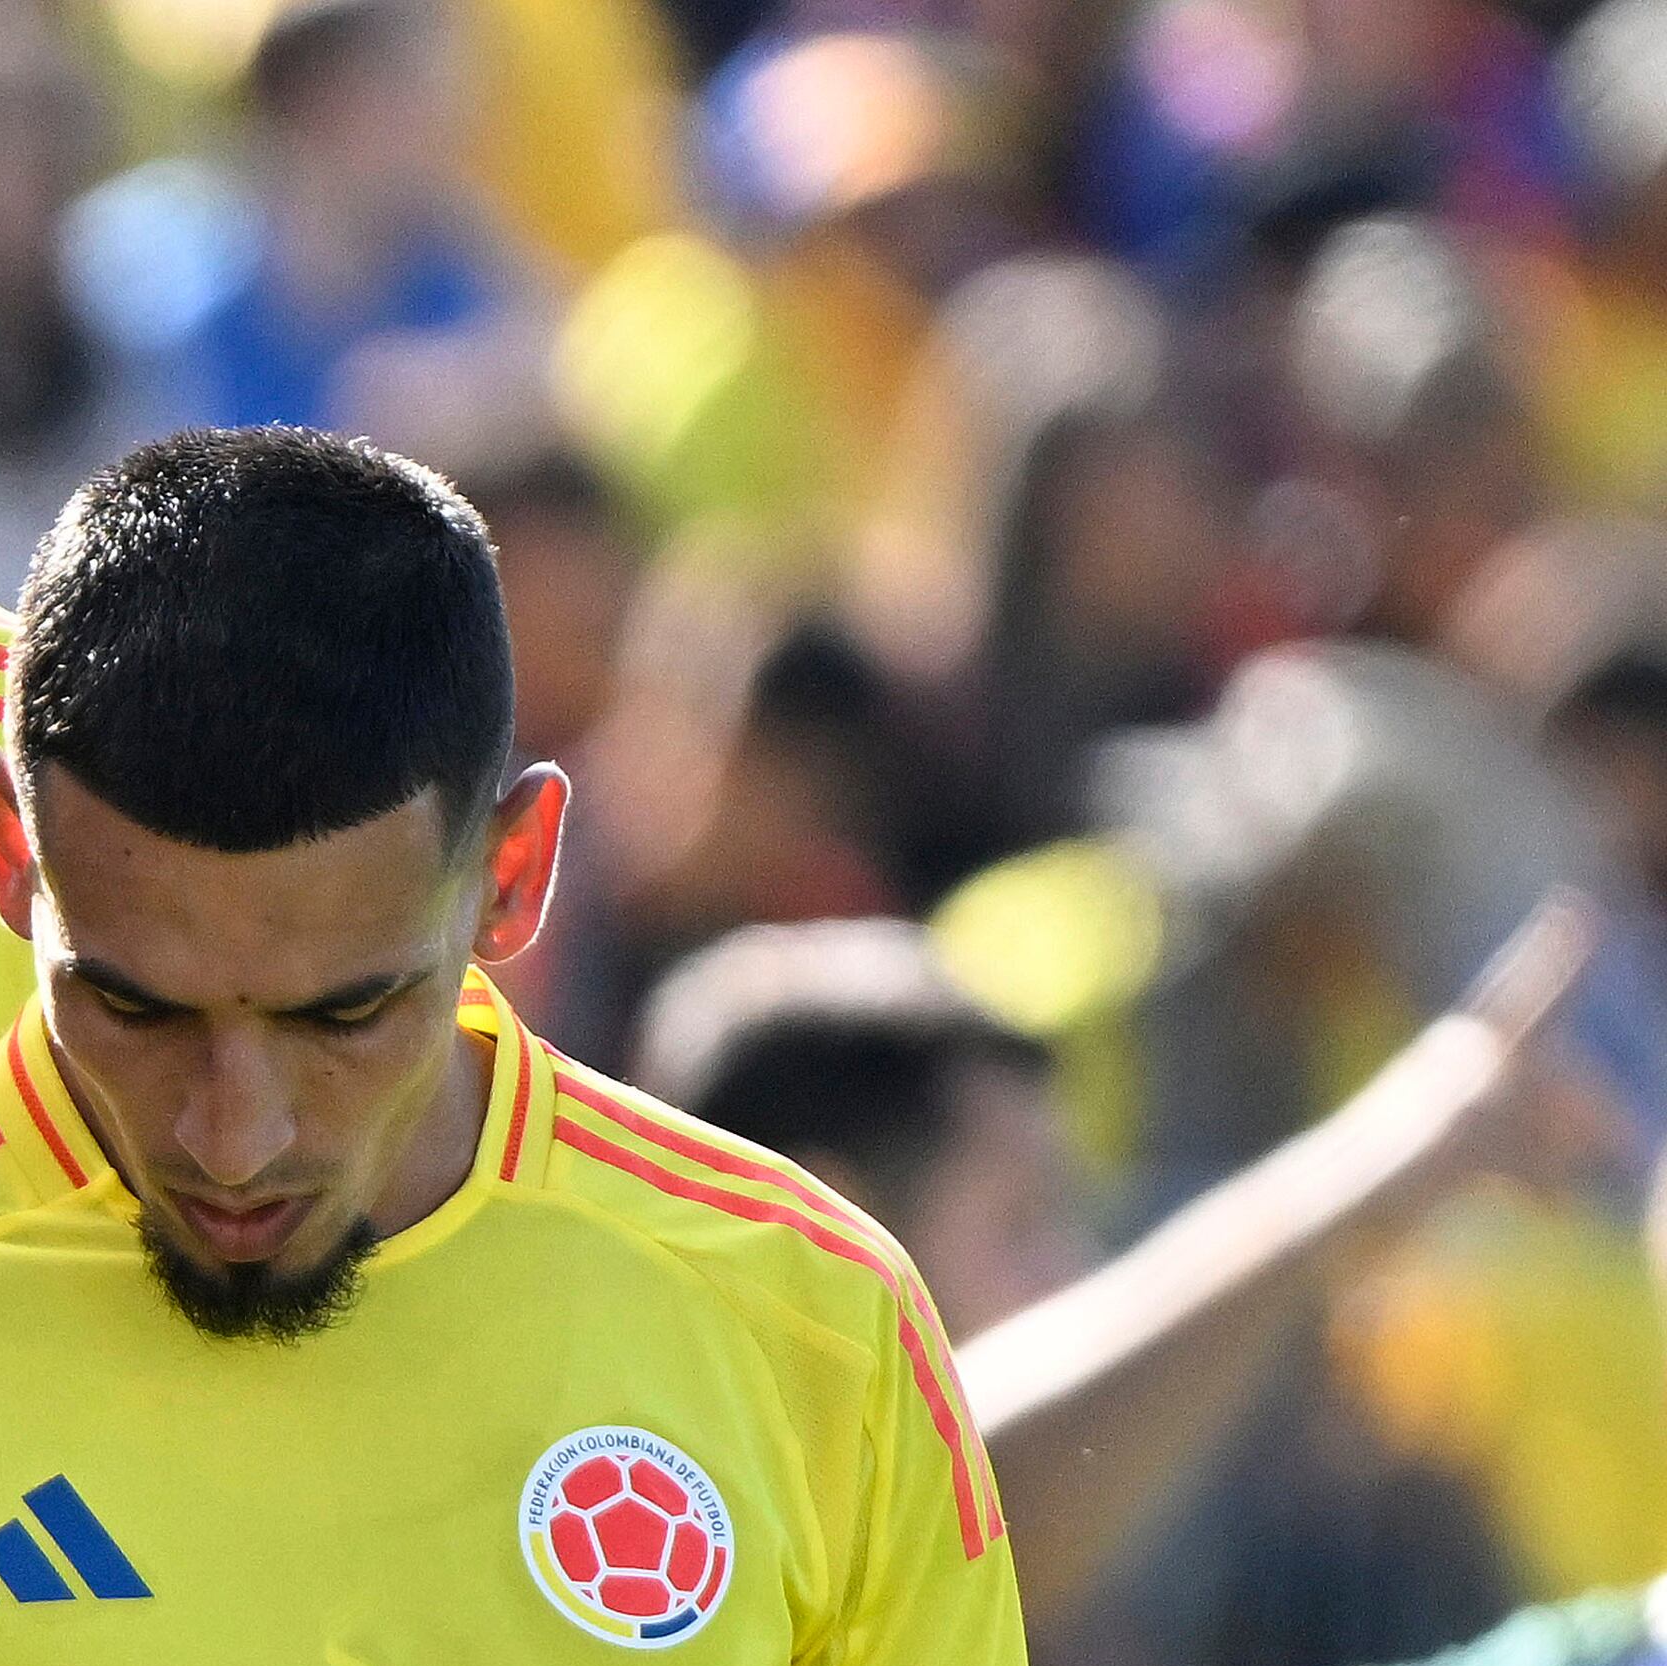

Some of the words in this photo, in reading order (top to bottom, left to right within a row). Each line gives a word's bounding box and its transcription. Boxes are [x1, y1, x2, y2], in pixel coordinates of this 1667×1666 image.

[578, 1434, 675, 1468] COLOMBIANA
[676, 1463, 696, 1483] DE
[691, 1480, 726, 1540] FUTBOL
